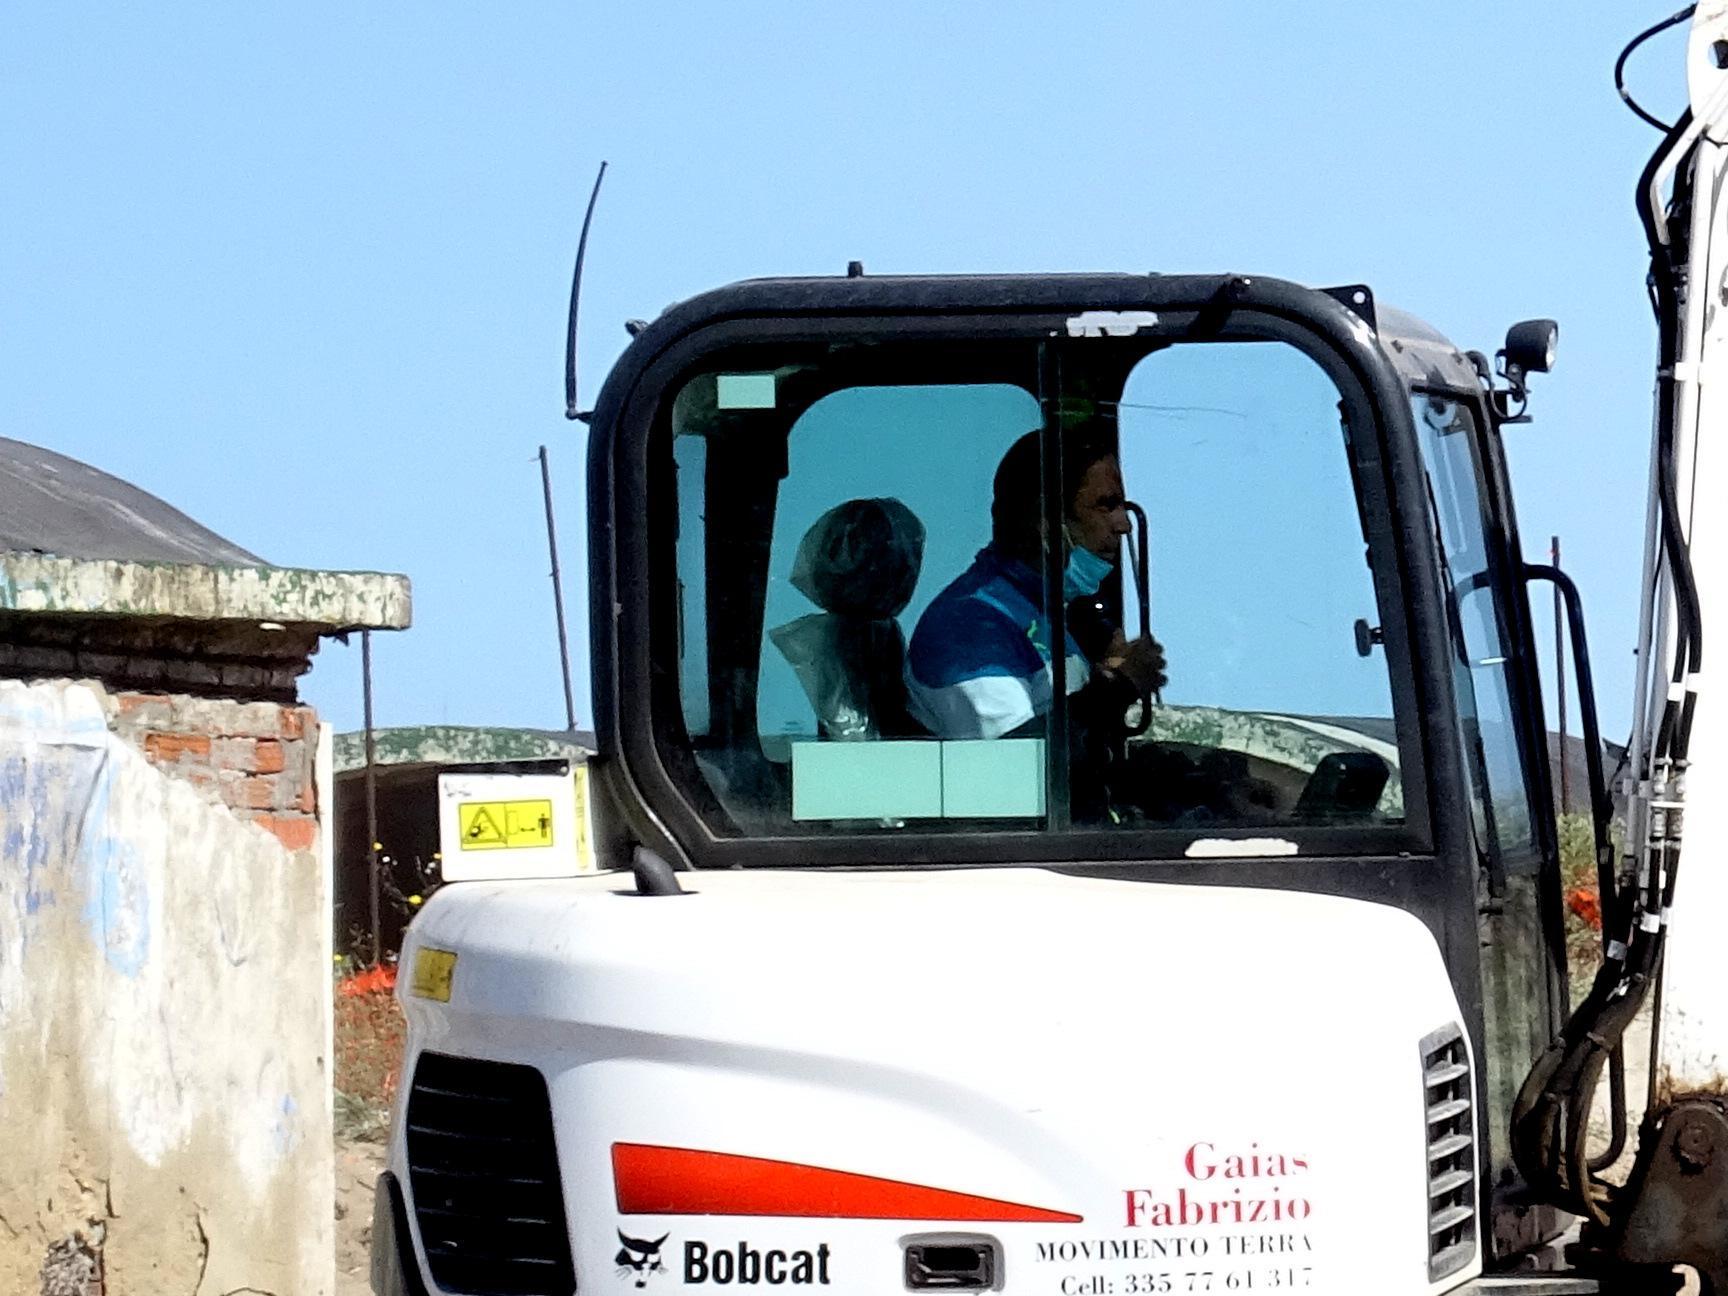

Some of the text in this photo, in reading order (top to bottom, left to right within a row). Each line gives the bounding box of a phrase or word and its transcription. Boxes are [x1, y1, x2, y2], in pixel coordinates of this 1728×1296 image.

[1184, 1141, 1309, 1181] Gaias
[1121, 1185, 1312, 1228] Fabrizio
[683, 1240, 831, 1285] Bobcat
[1035, 1234, 1313, 1262] MOVIMENTO TERRA
[1060, 1275, 1114, 1296] Cell:
[1124, 1272, 1173, 1294] 335
[1184, 1271, 1214, 1291] 77
[1225, 1269, 1254, 1290] 61
